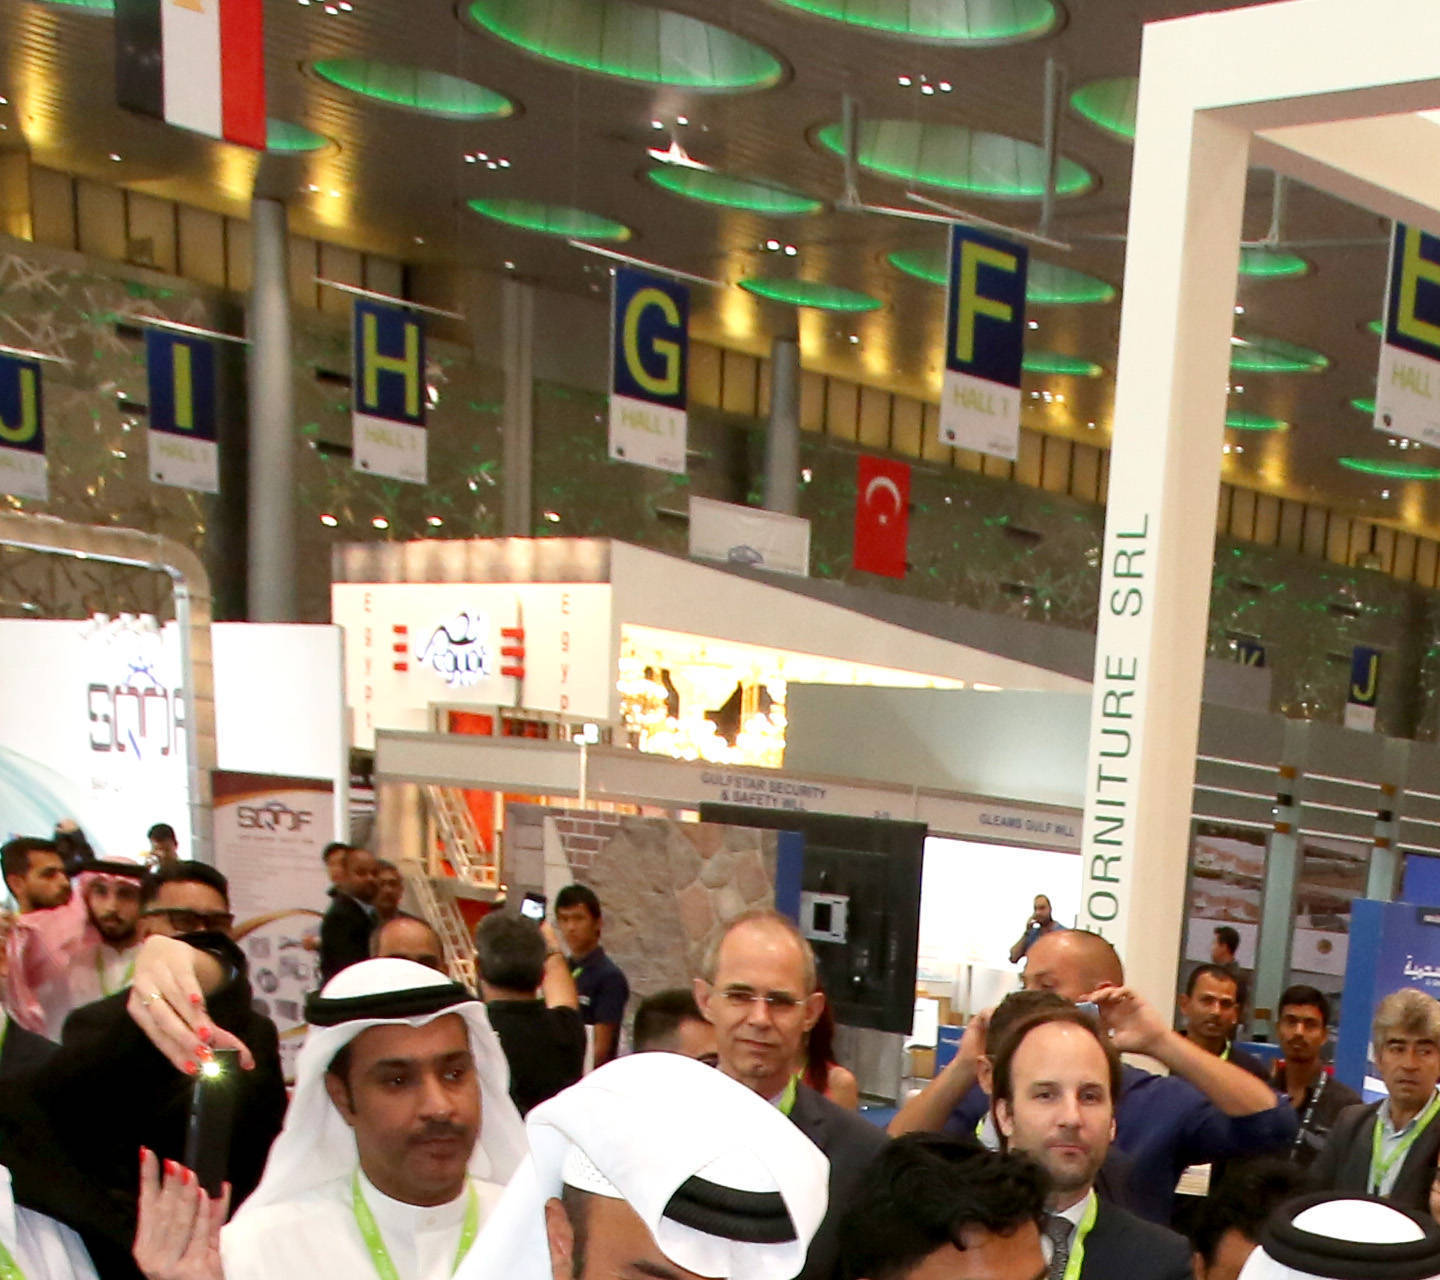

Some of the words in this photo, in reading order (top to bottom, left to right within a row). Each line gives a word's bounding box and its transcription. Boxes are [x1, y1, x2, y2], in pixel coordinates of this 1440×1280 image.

[623, 287, 681, 396] G
[957, 243, 1017, 364] F
[173, 343, 194, 429] I
[363, 314, 419, 416] H
[1109, 513, 1150, 617] SRL
